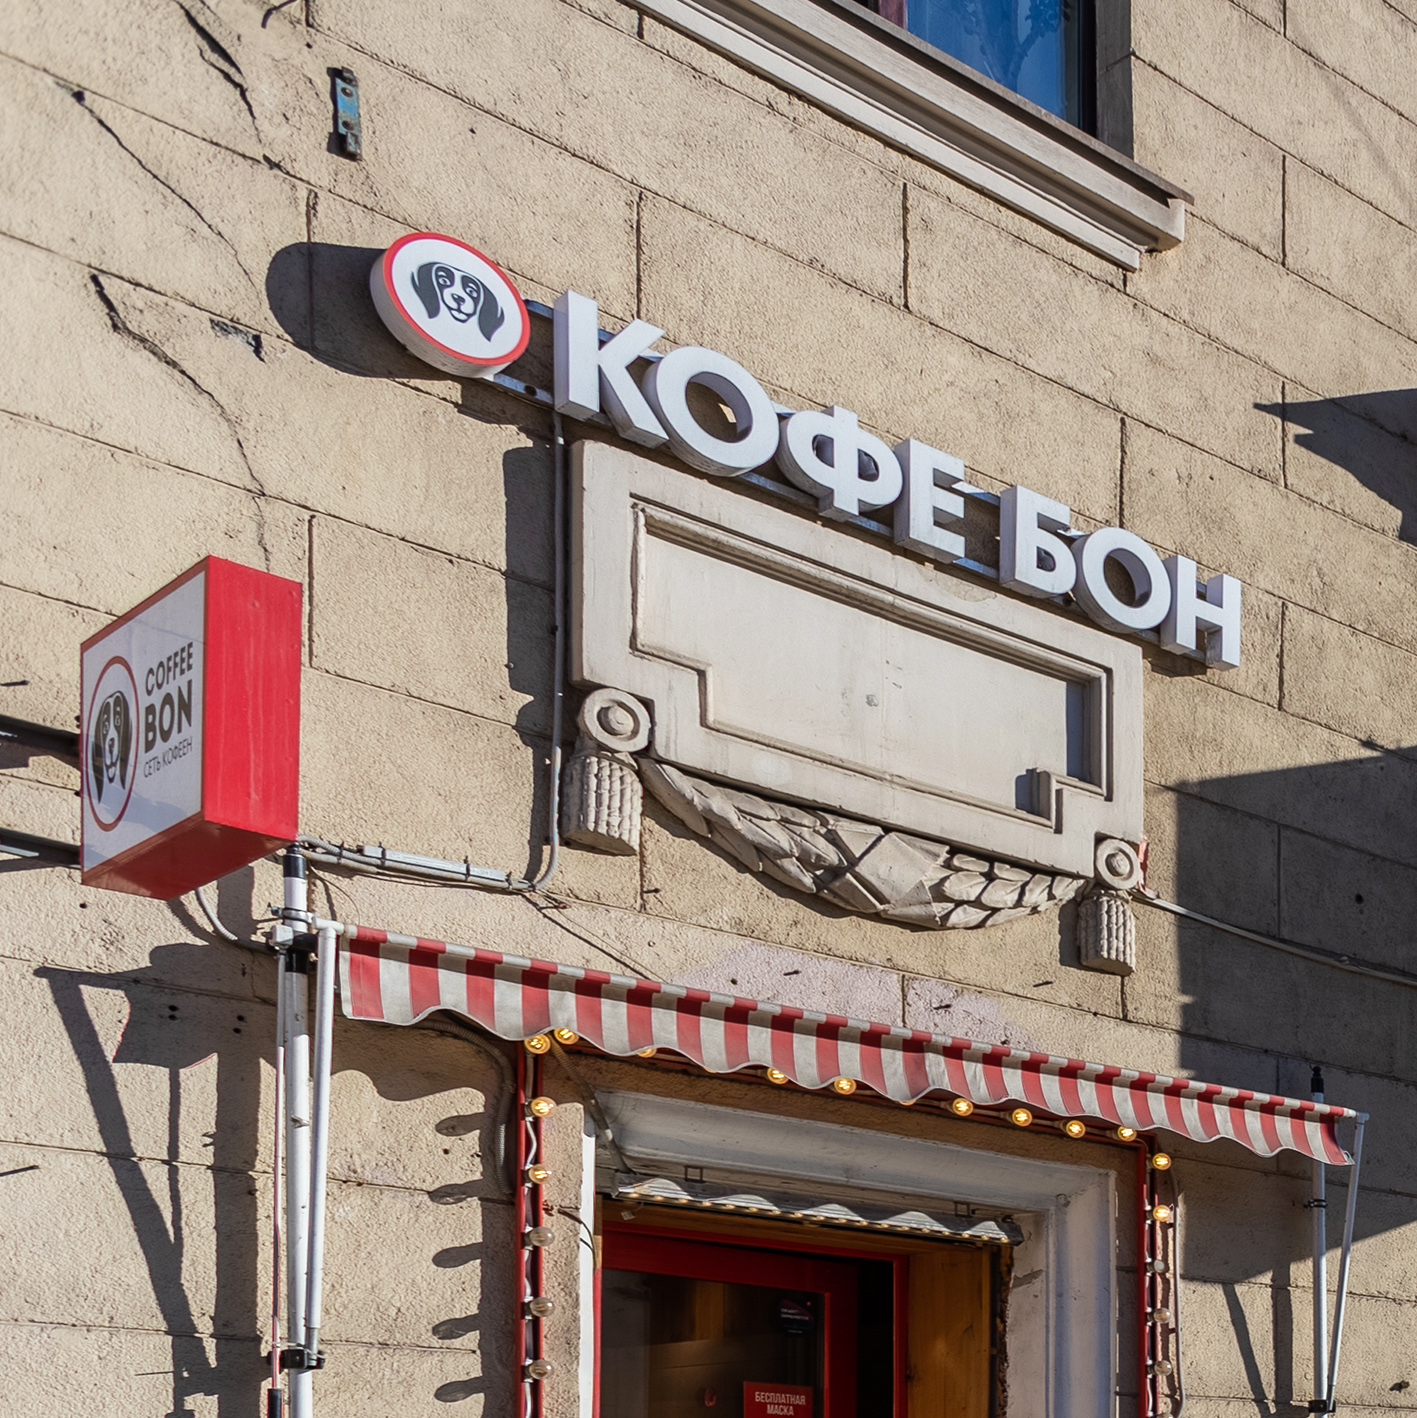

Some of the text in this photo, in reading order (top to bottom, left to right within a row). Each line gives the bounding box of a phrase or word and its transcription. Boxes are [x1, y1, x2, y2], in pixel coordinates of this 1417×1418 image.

[553, 289, 1242, 671] КОФЕ БОН
[145, 641, 194, 697] COFFEE
[144, 678, 193, 754] BON
[143, 755, 162, 779] СЕТЬ
[755, 1391, 806, 1406] БЕСПЛАТНАЯ
[767, 1403, 794, 1417] МАСКА
